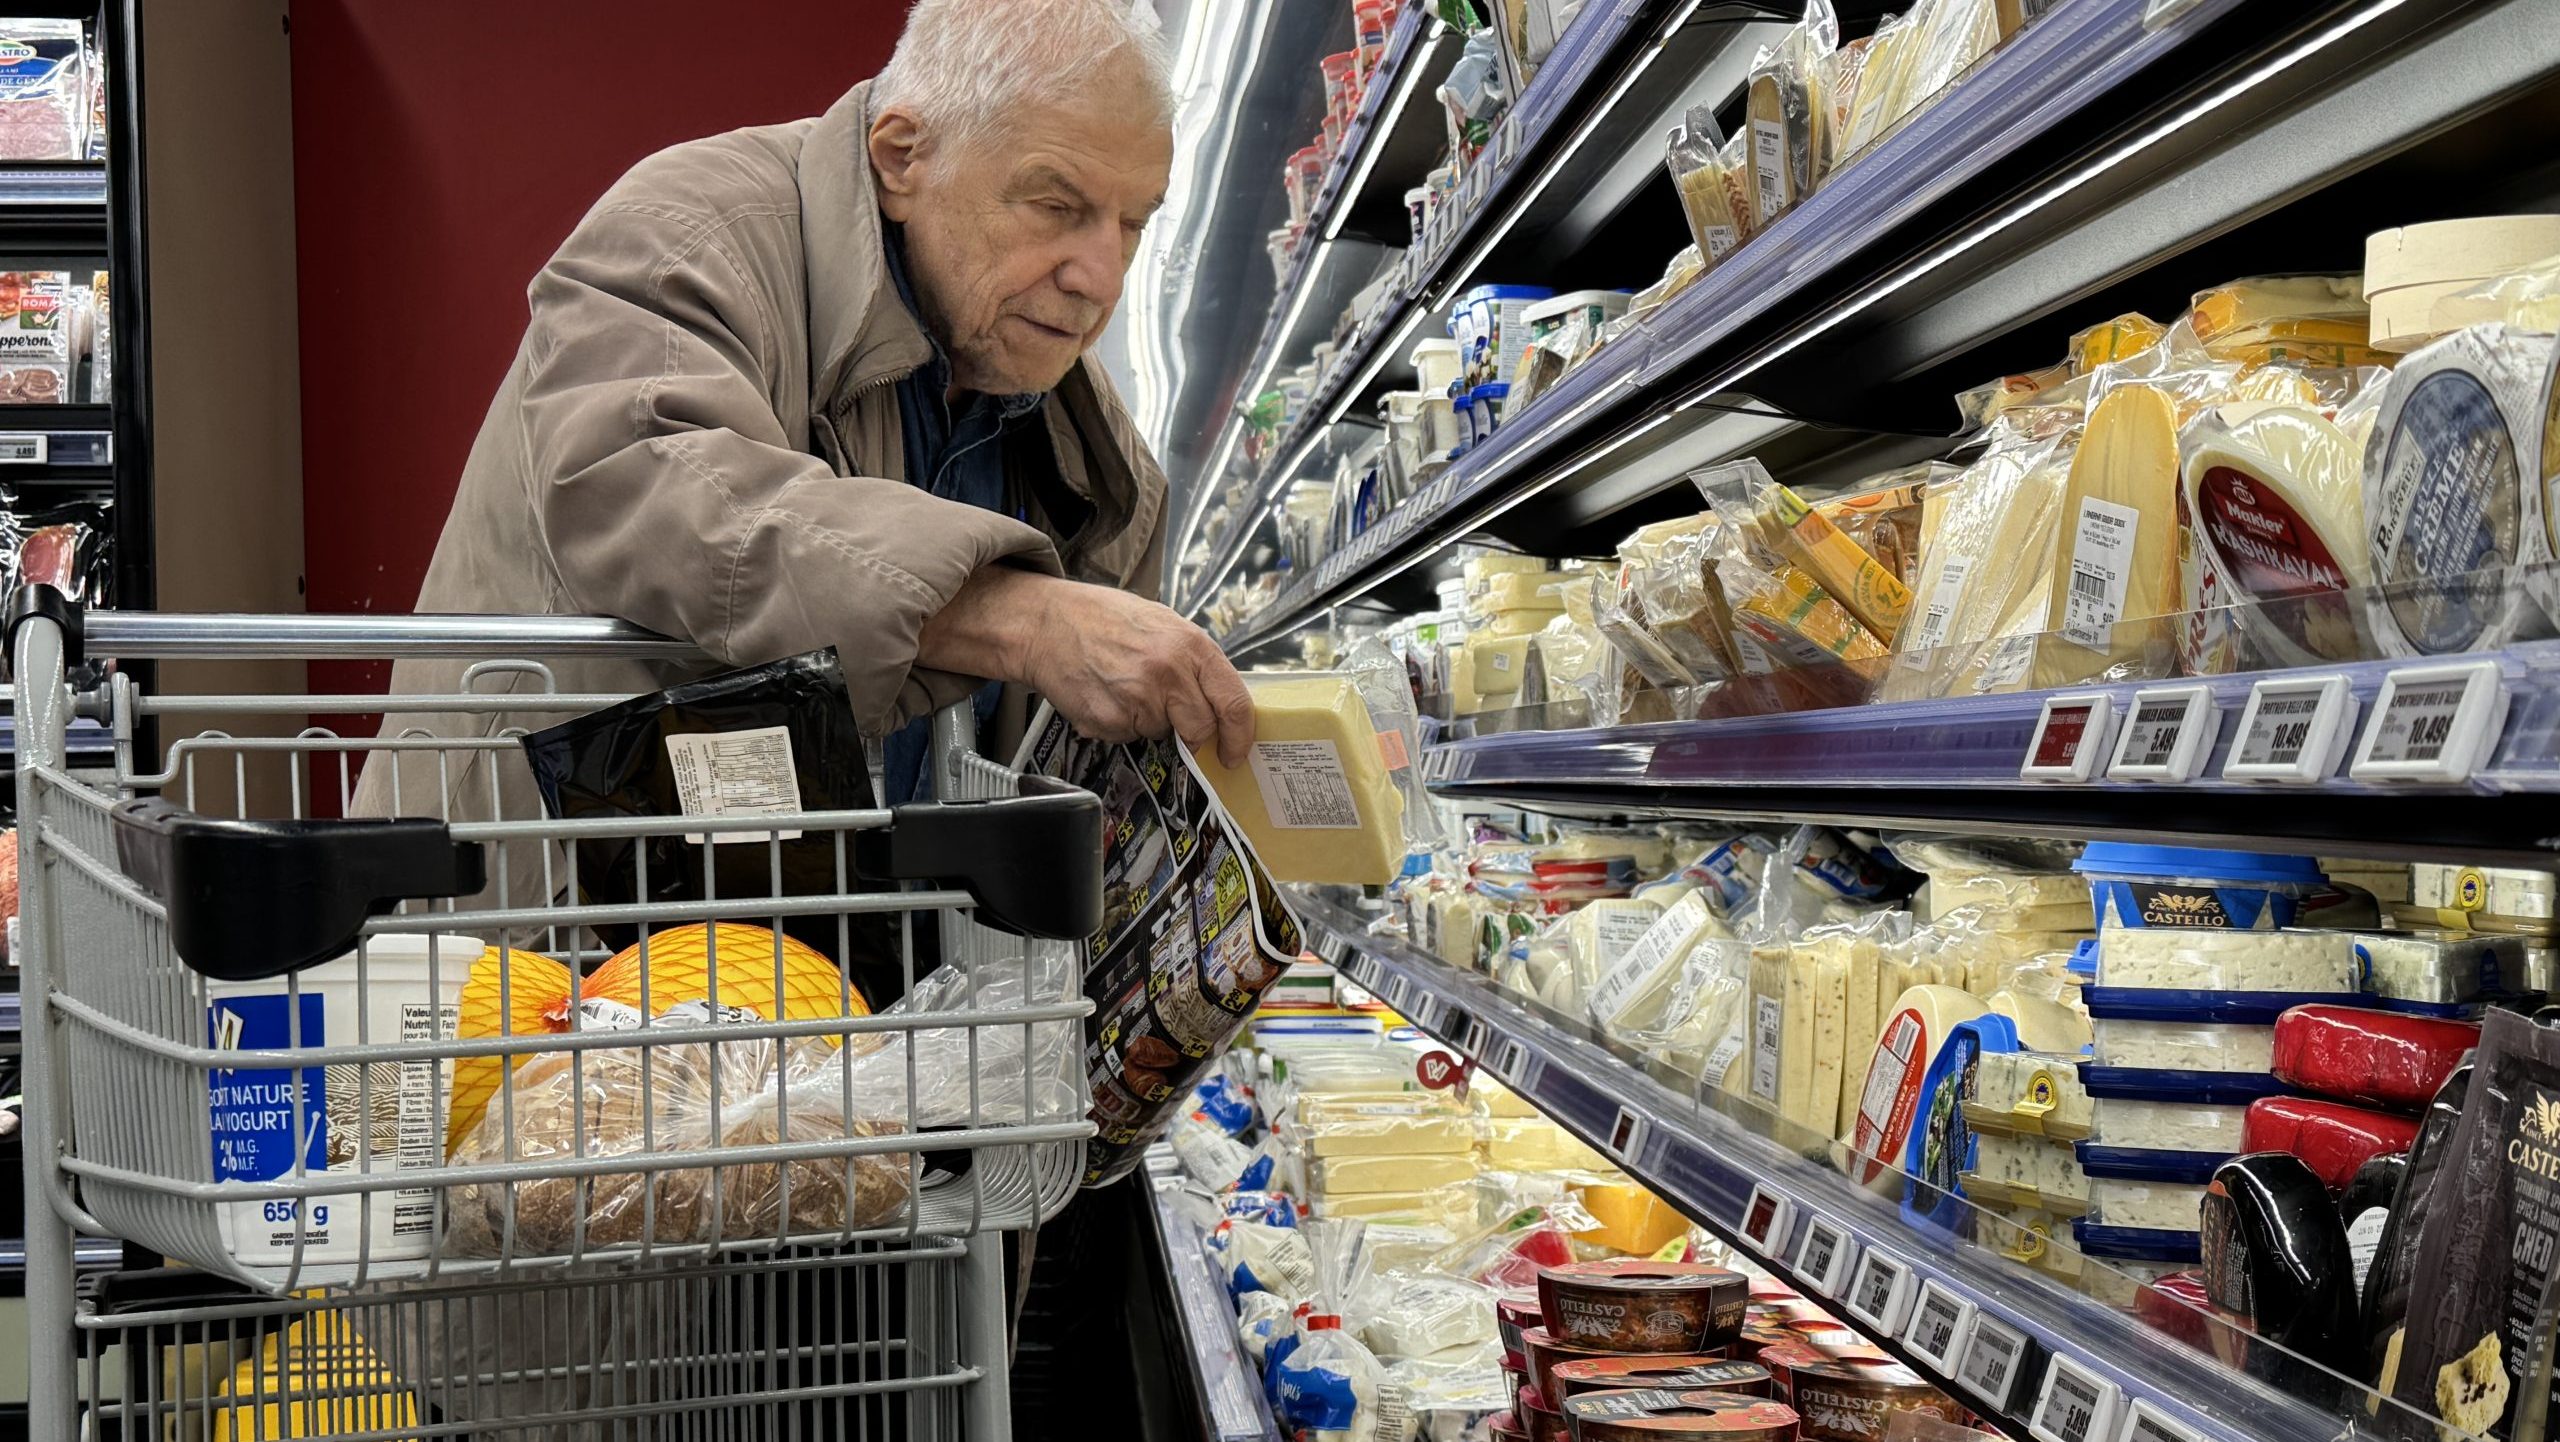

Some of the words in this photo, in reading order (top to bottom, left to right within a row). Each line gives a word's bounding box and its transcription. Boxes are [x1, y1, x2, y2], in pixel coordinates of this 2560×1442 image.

[2414, 457, 2443, 530] BELLE
[2225, 500, 2283, 535] Makler
[2211, 522, 2343, 592] KASHKAVAL
[2143, 911, 2226, 928] CASTELLO
[405, 1008, 431, 1017] Valeu
[232, 1083, 311, 1106] NATURE
[225, 1110, 290, 1132] YOGURT
[2508, 1139, 2560, 1181] CASTE
[313, 1205, 329, 1226] g
[2512, 1222, 2554, 1273] CHED
[1560, 1298, 1626, 1317] CASTELLO
[1714, 1300, 1744, 1316] CASTELLO
[1801, 1388, 1888, 1412] CASTELLO
